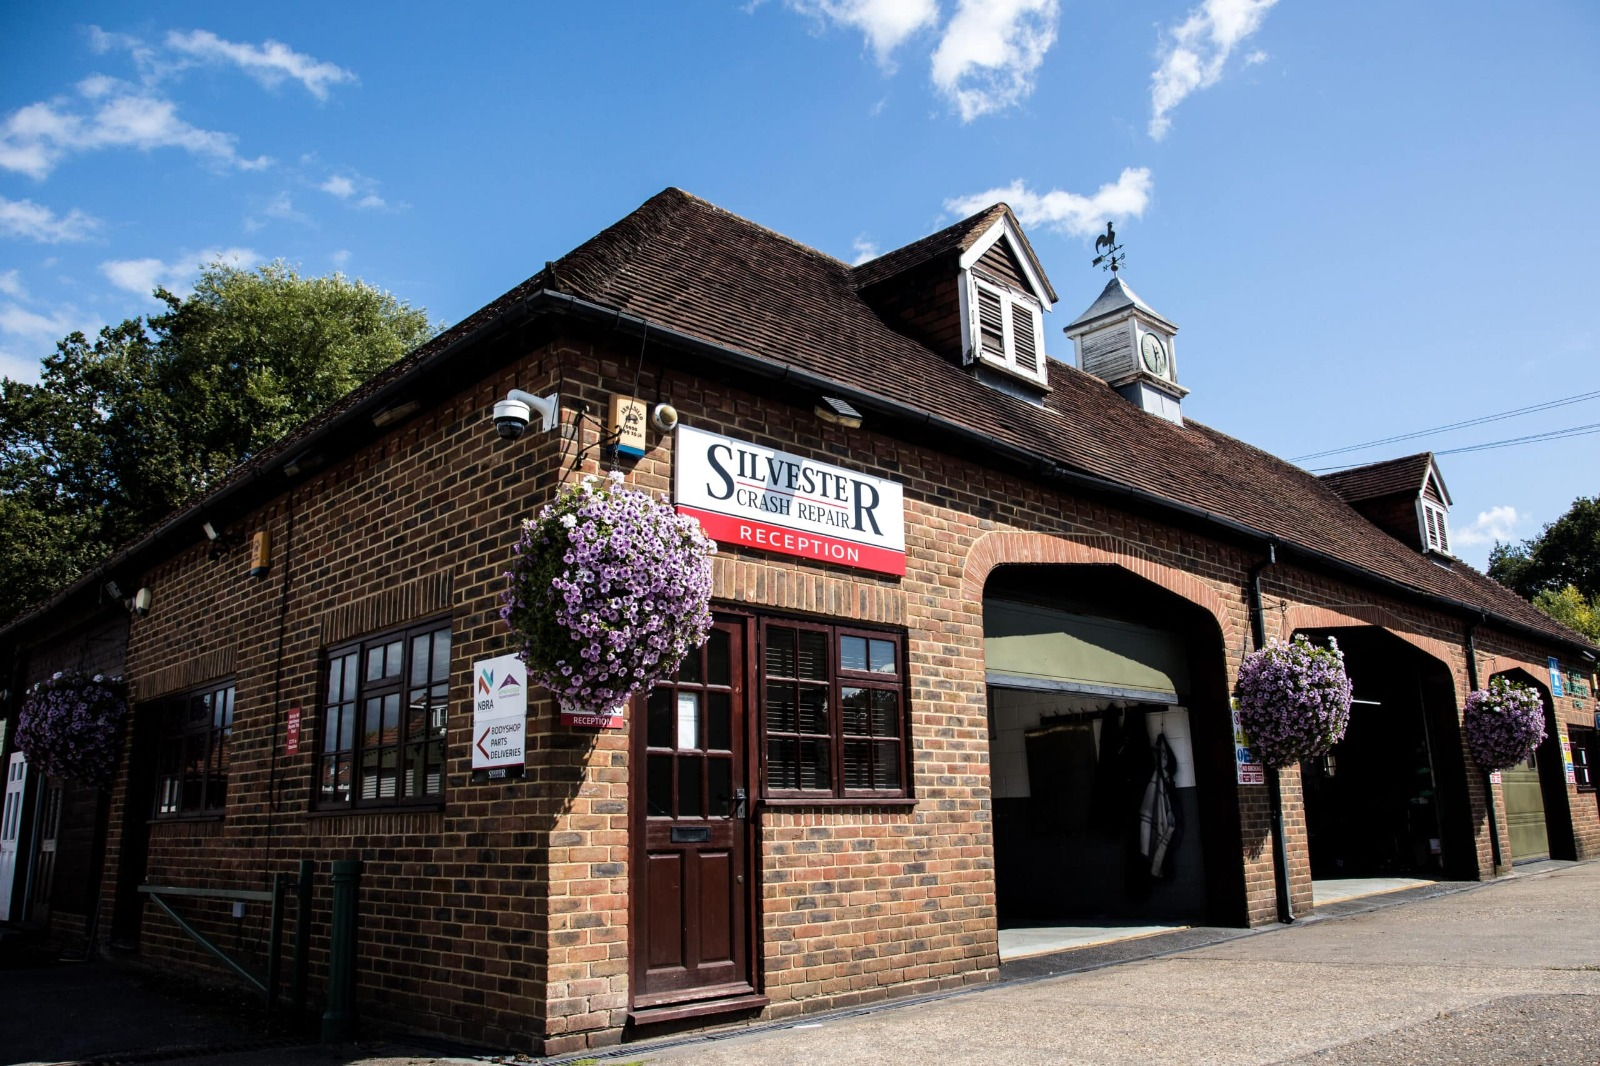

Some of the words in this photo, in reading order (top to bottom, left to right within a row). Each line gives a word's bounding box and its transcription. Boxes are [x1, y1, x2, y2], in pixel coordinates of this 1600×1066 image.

[620, 405, 644, 421] ARMDILLO
[706, 443, 884, 537] SILVESTER
[736, 488, 791, 516] CRASH
[798, 502, 850, 529] REPAIR
[740, 525, 859, 562] RECEPTION
[478, 699, 494, 711] NBRA
[574, 716, 612, 726] RECEPTION
[491, 724, 521, 735] BODYSHOP
[490, 737, 508, 747] PARTS
[490, 748, 521, 759] DELIVERIES
